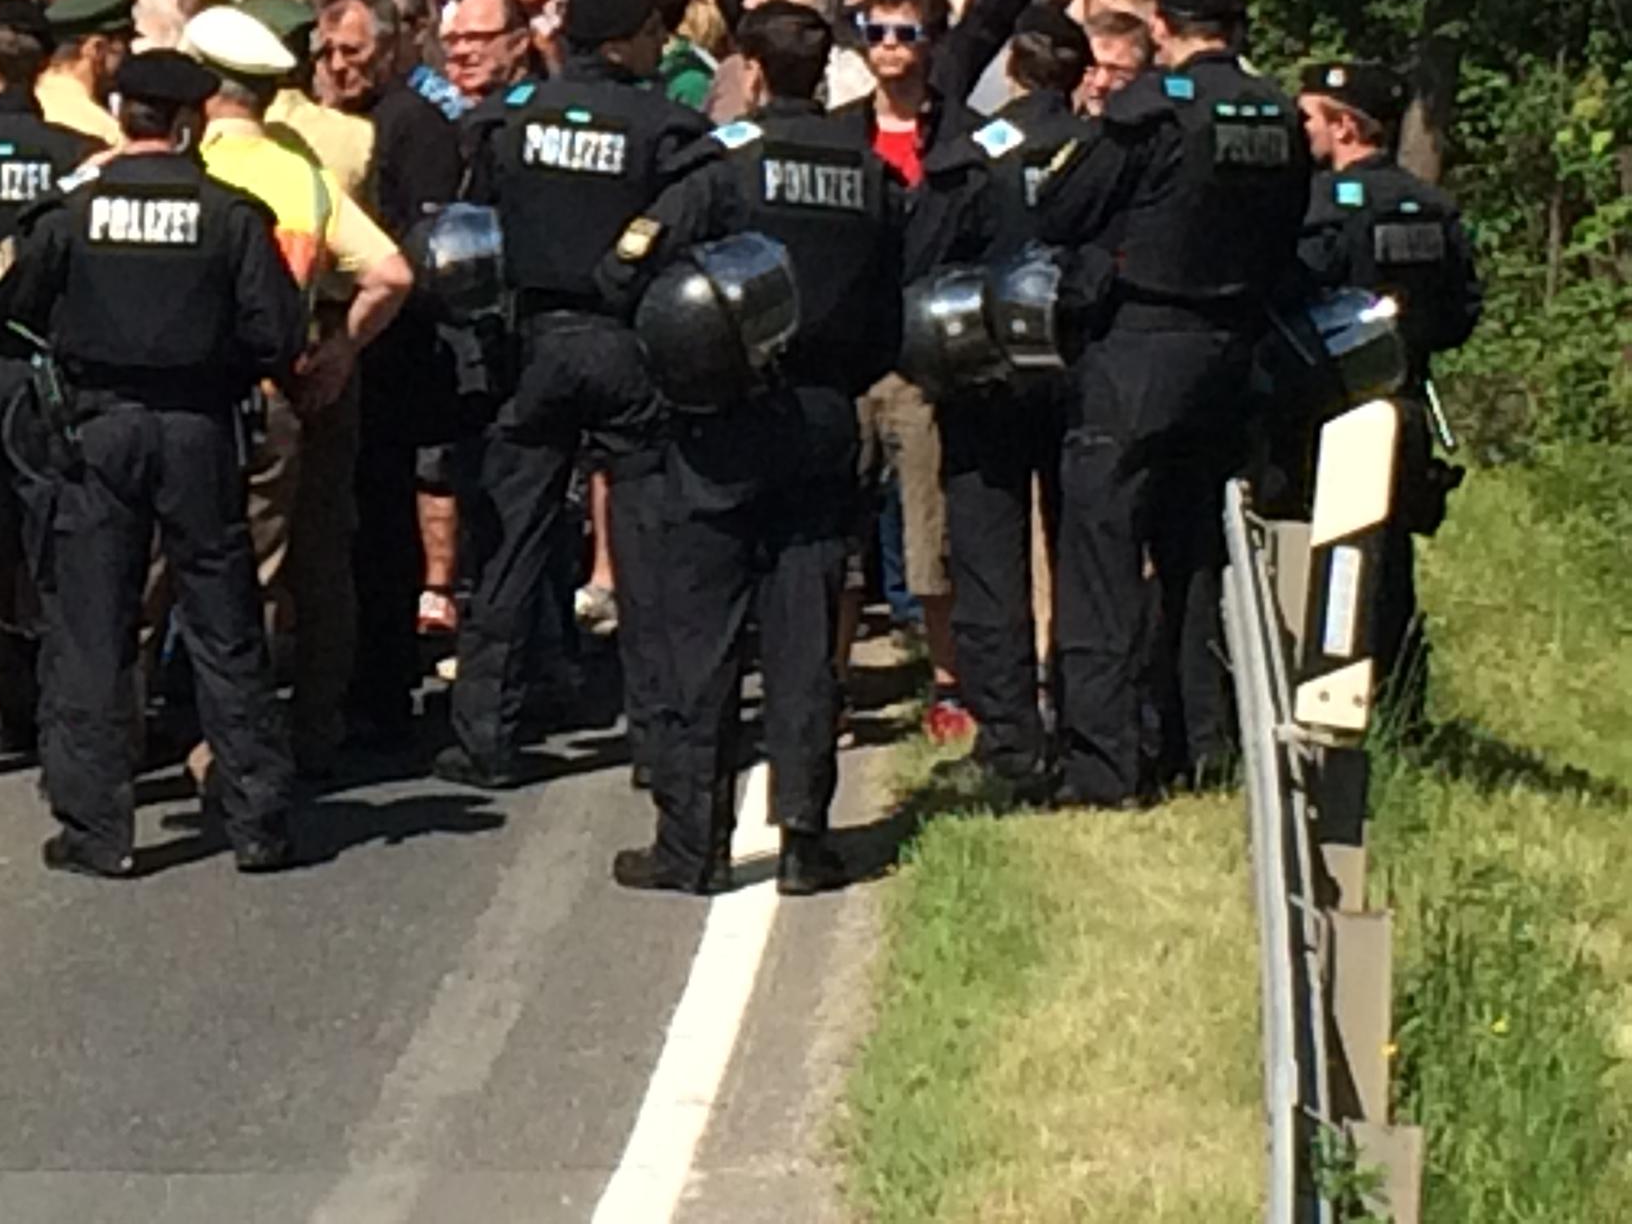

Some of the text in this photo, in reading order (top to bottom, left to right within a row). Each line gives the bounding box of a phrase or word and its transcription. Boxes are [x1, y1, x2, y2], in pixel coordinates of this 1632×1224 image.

[524, 123, 626, 173] POLIZEI
[763, 159, 864, 210] POLIZEI
[89, 196, 200, 243] POLIZEI
